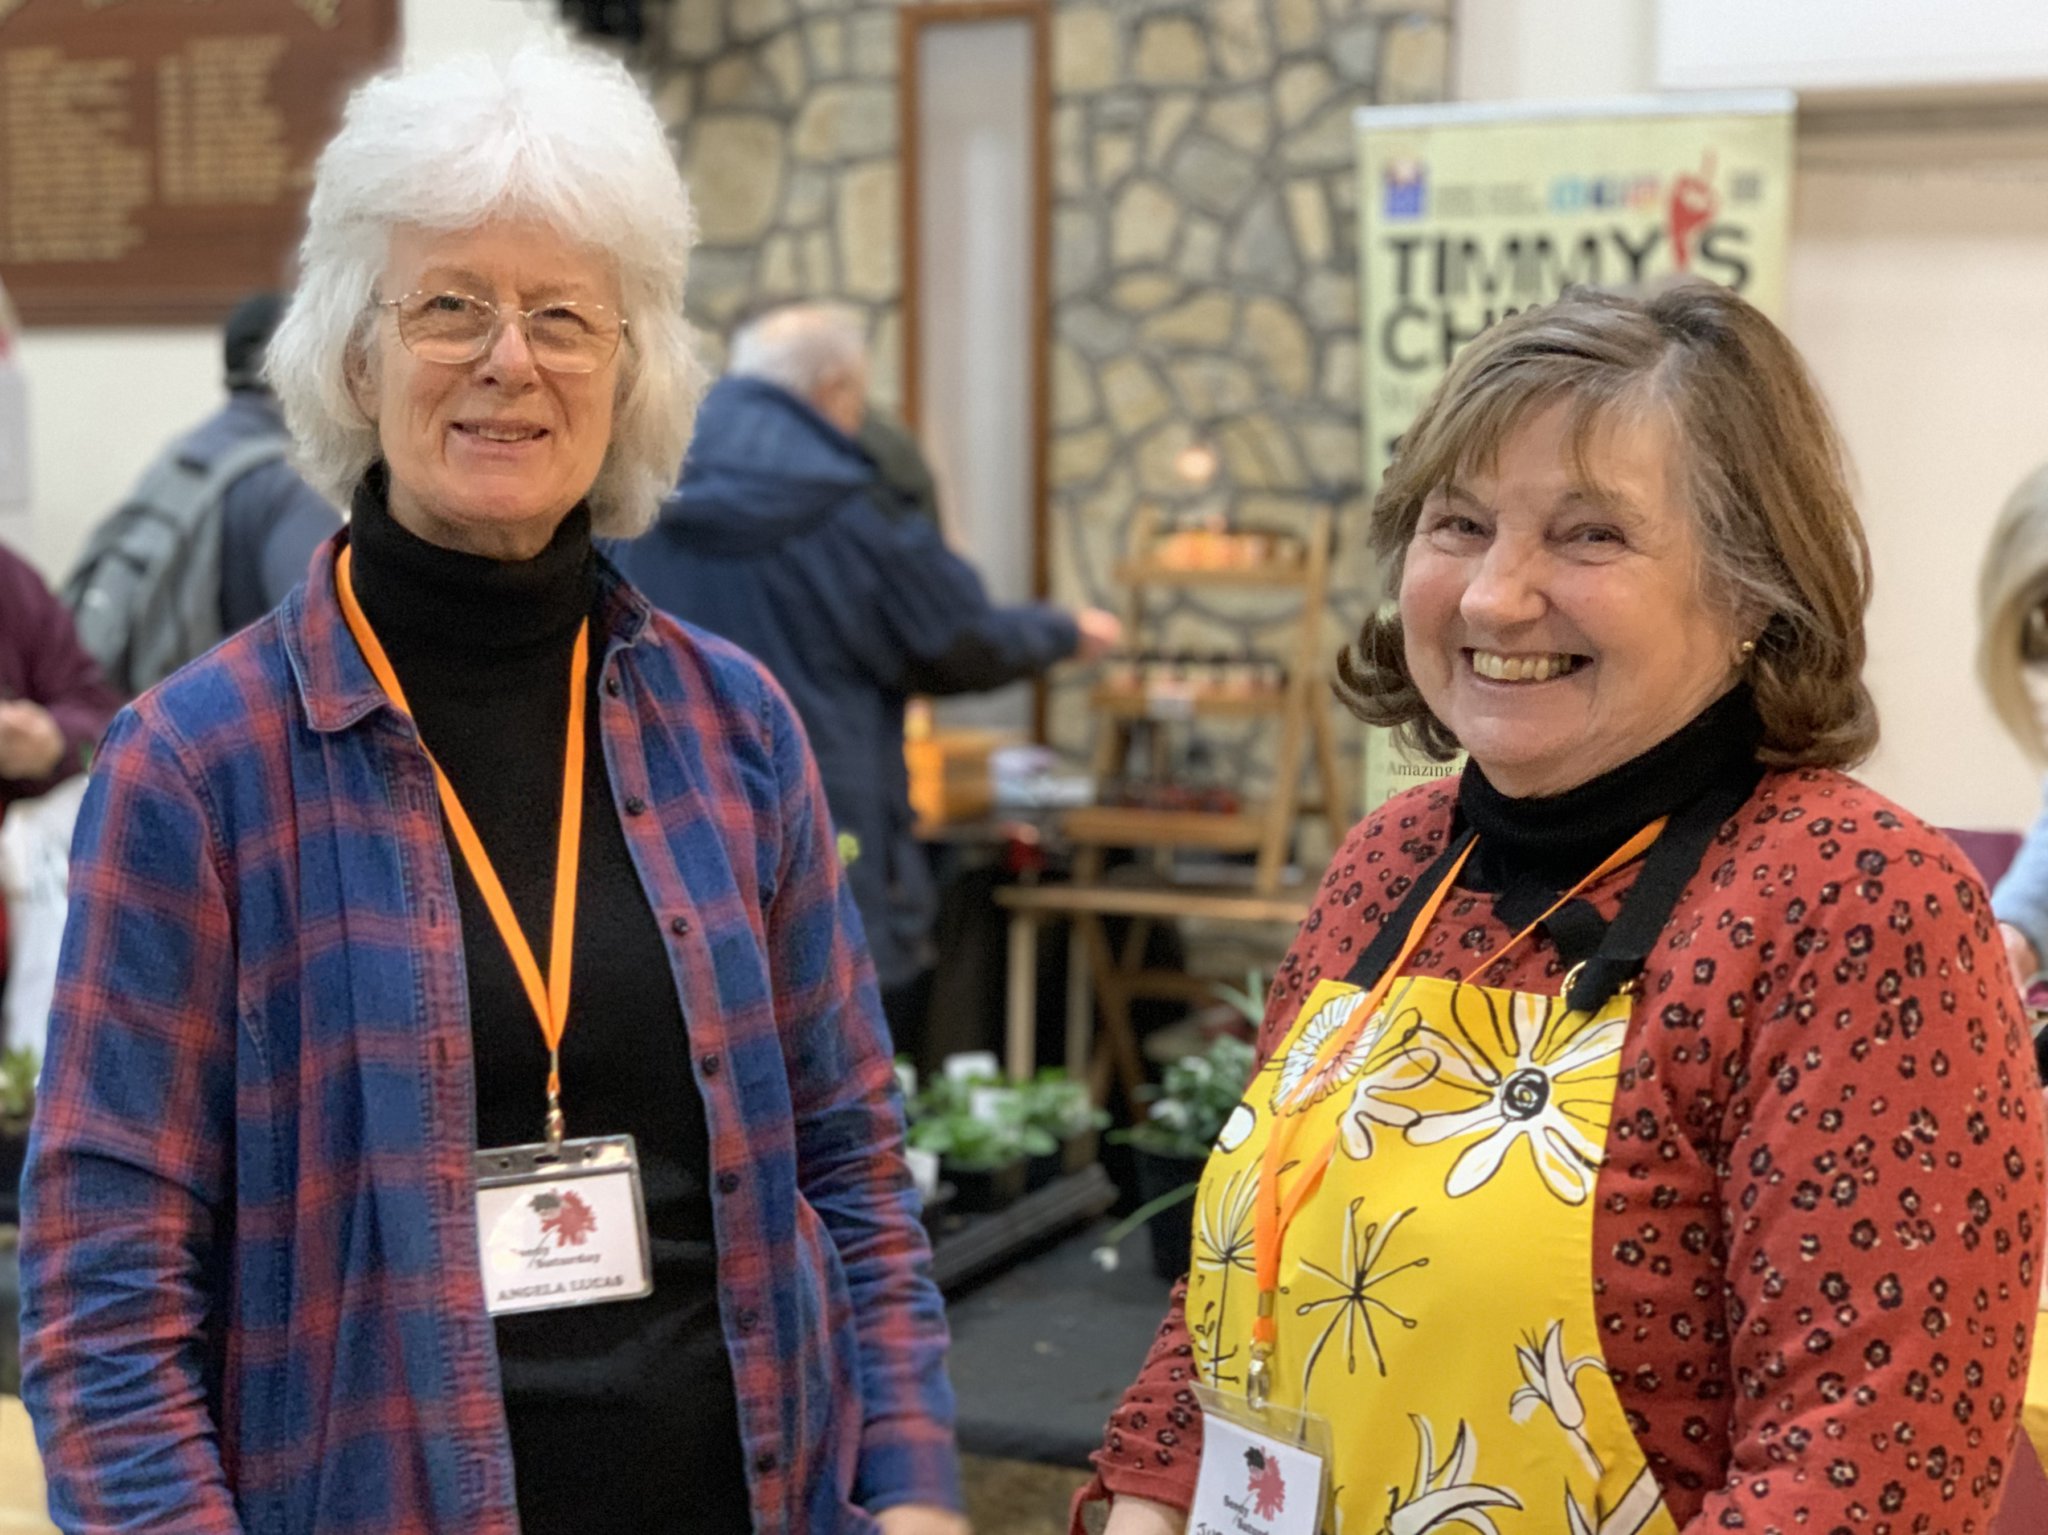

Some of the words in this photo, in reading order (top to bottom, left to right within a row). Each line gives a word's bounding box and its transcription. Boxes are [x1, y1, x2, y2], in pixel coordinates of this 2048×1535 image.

[1386, 761, 1452, 778] Amazing
[497, 1283, 567, 1302] ANGELA
[570, 1275, 624, 1293] LUCAS
